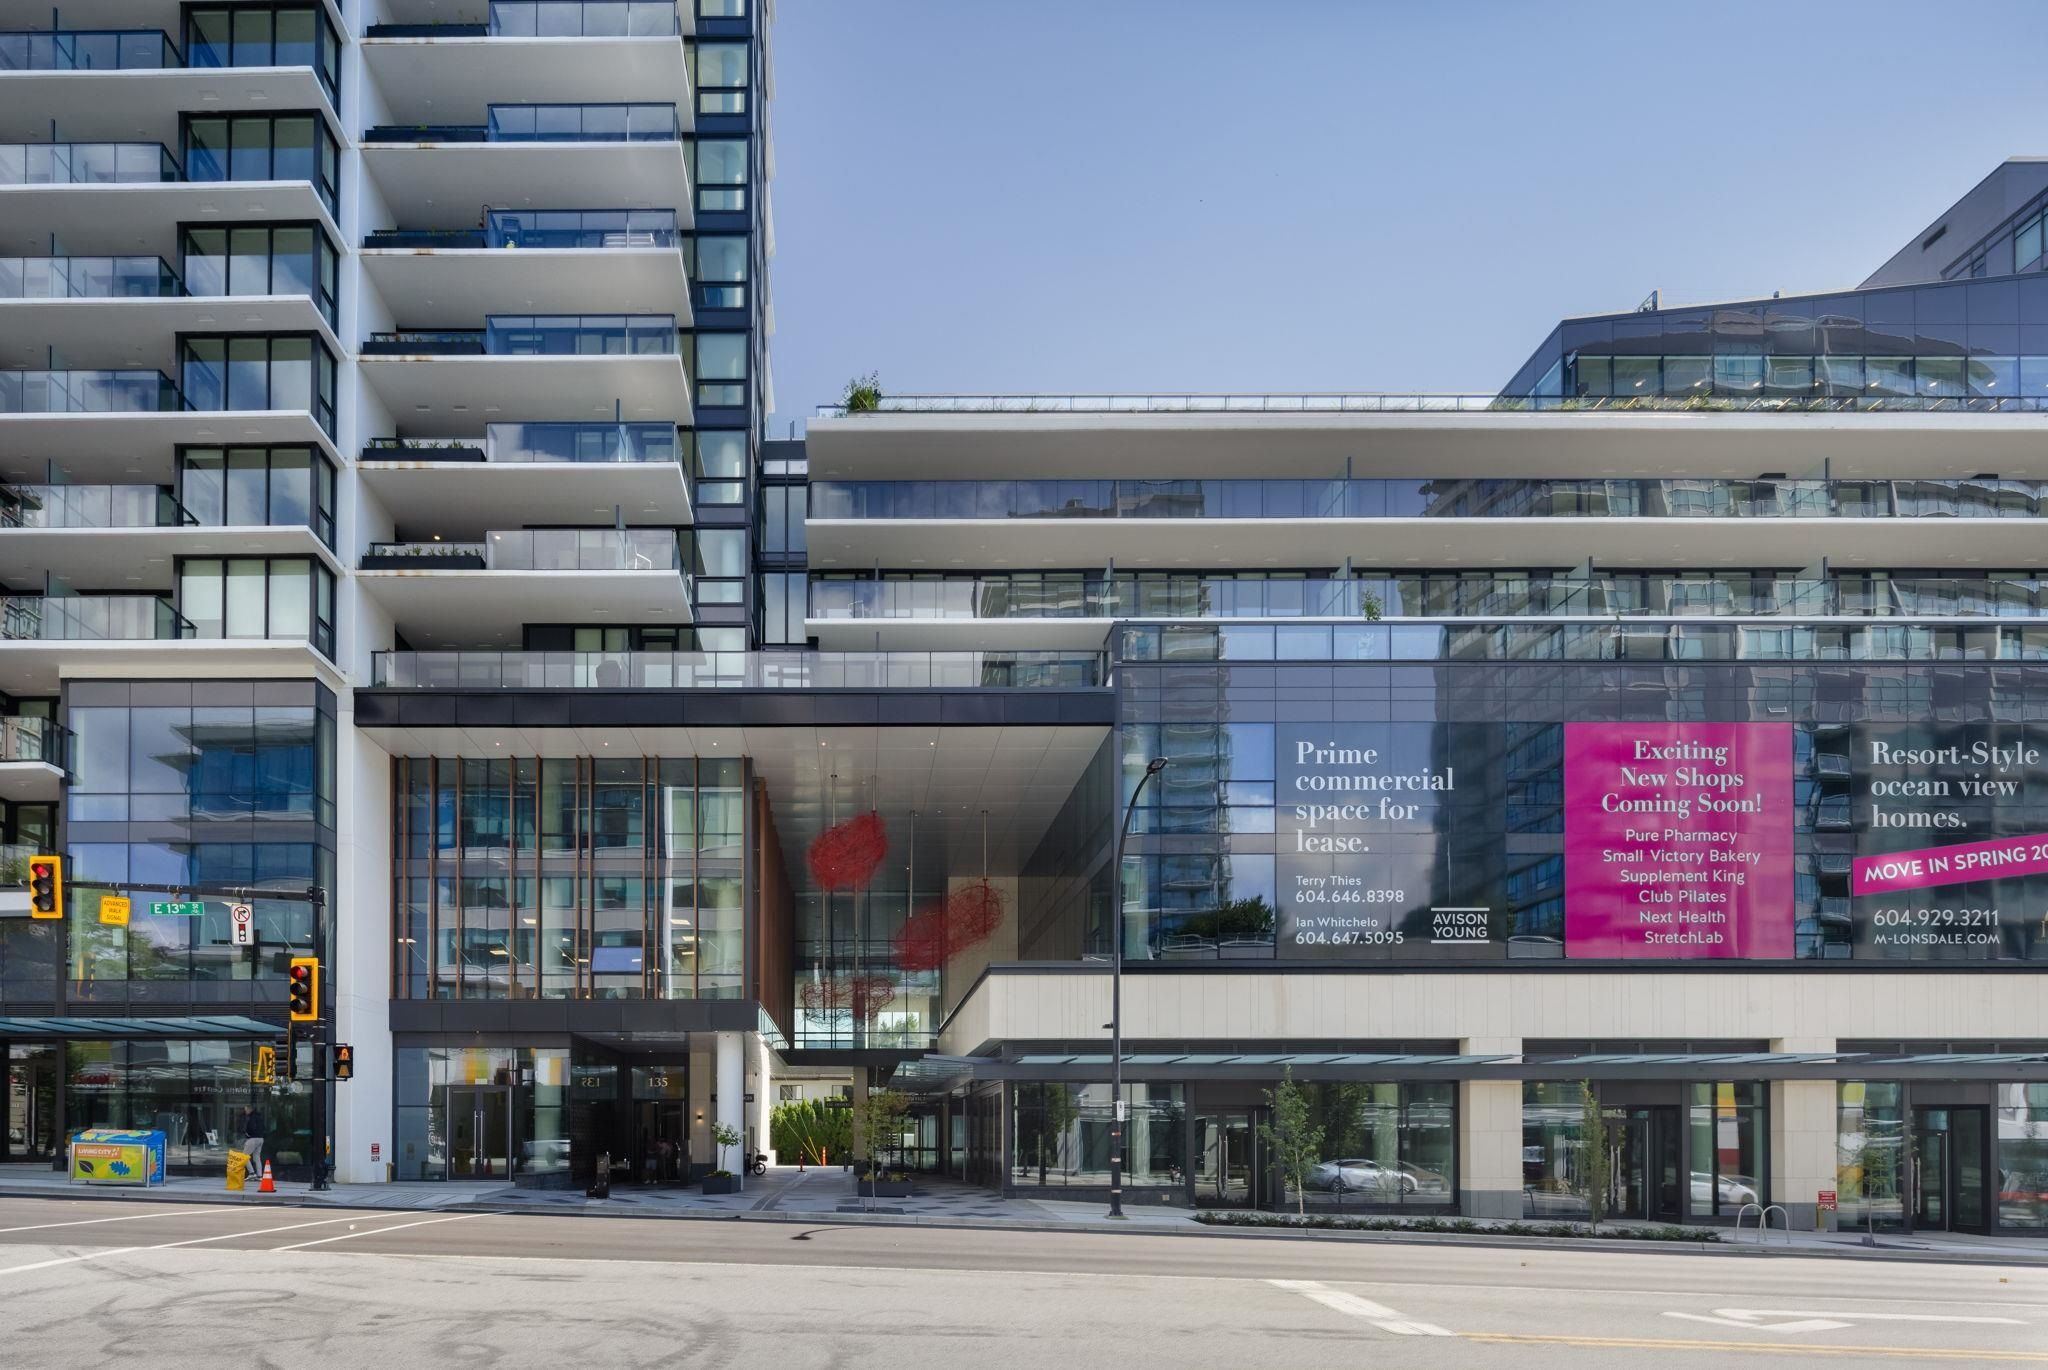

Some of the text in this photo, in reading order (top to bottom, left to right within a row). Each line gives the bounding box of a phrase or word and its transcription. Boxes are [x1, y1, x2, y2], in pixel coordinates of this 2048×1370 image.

[1296, 741, 1378, 764] Prime
[1633, 740, 1728, 766] Exciting
[1871, 741, 2040, 773] Resort-Style
[1296, 767, 1455, 791] commercial
[1620, 766, 1744, 793] New Shops
[1871, 773, 2018, 796] ocean view
[1296, 797, 1419, 828] space for
[1602, 793, 1762, 819] Coming Soon!
[1872, 804, 1967, 828] homes.
[1296, 829, 1369, 852] lease.
[1625, 829, 1738, 845] Pure Pharmacy
[1603, 849, 1761, 865] Small Victory Bakery
[1865, 859, 1924, 883] MOVE
[1929, 857, 1949, 874] IN
[1955, 846, 2027, 871] SPRING
[1296, 875, 1361, 888] Terry Thies
[1620, 869, 1745, 885] Supplement King
[1296, 889, 1405, 903] 604.646.8398
[1639, 889, 1727, 903] Club Pilates
[154, 903, 162, 914] E
[167, 903, 186, 914] 13th
[1296, 916, 1379, 928] Ian Whitchelo
[1433, 913, 1488, 925] AVISON
[1639, 911, 1726, 924] Next Health
[1873, 909, 1999, 926] 604.929.3211
[1296, 931, 1404, 945] 604.647.5095
[1433, 926, 1488, 938] YOUNG
[1644, 931, 1724, 945] StretchLab
[1874, 933, 2001, 945] M-LONSDALE.COM
[649, 1077, 668, 1087] 135
